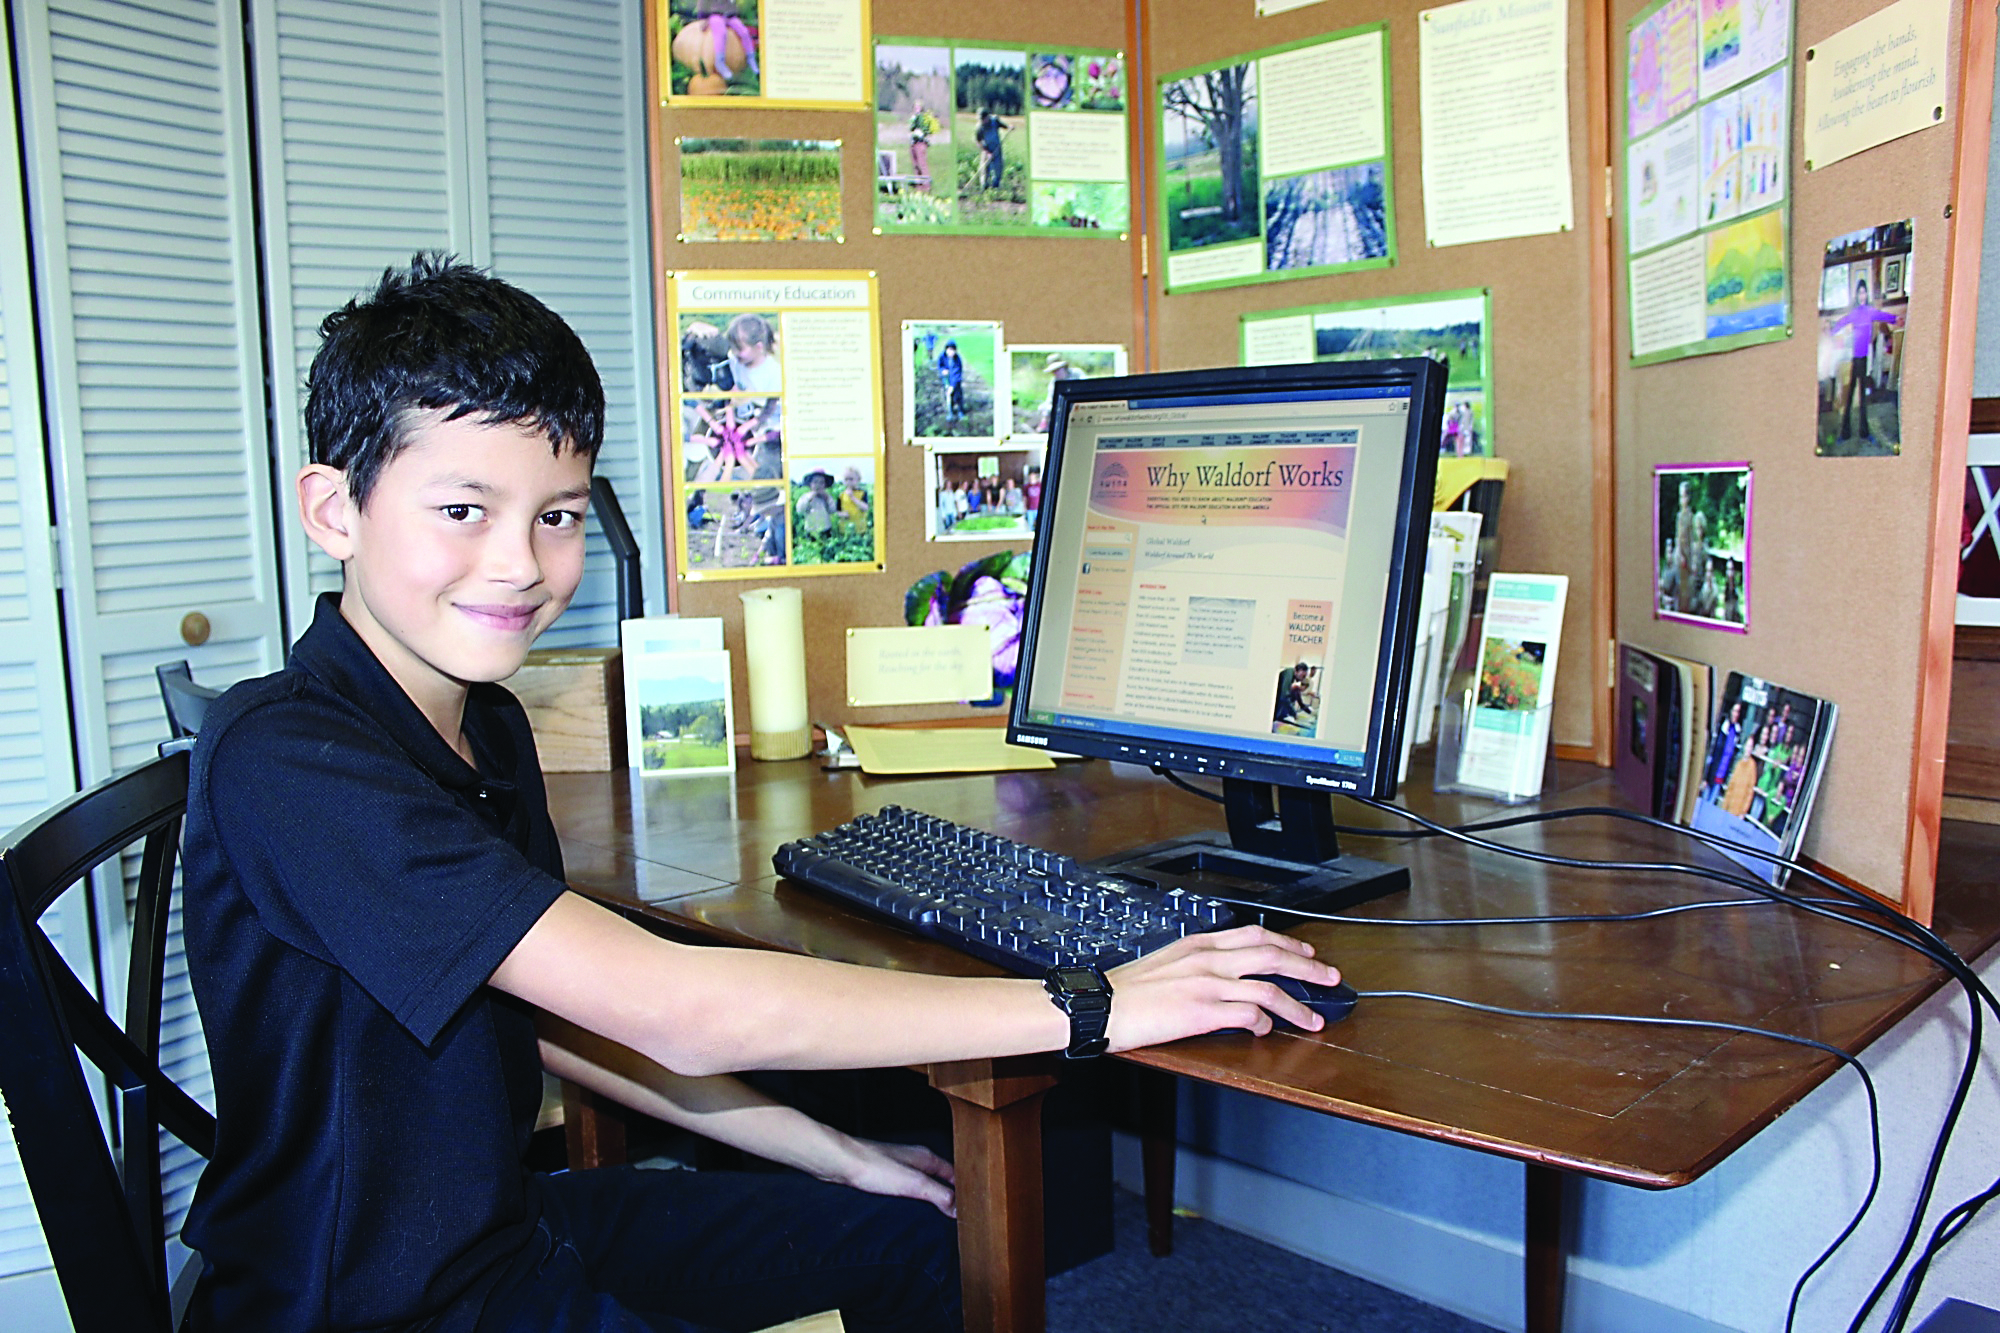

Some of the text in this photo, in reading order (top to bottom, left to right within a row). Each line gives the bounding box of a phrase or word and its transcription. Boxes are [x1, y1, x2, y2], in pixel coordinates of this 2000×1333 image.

[1833, 51, 1871, 79] Engaging
[1872, 40, 1886, 59] the
[1830, 72, 1876, 103] Awakening
[1877, 63, 1891, 82] the
[1815, 67, 1936, 133] Allowing the heart to flourish
[692, 285, 856, 303] Community Education
[1147, 460, 1343, 493] Why Waldorf Works
[1146, 536, 1190, 546] Global Waldorf
[1144, 551, 1166, 559] Waldorf
[1197, 552, 1214, 560] World
[1293, 611, 1319, 621] Become
[1289, 623, 1326, 632] WALDORF
[1289, 634, 1323, 644] TEACHER
[1016, 734, 1048, 747] SAMSUNG
